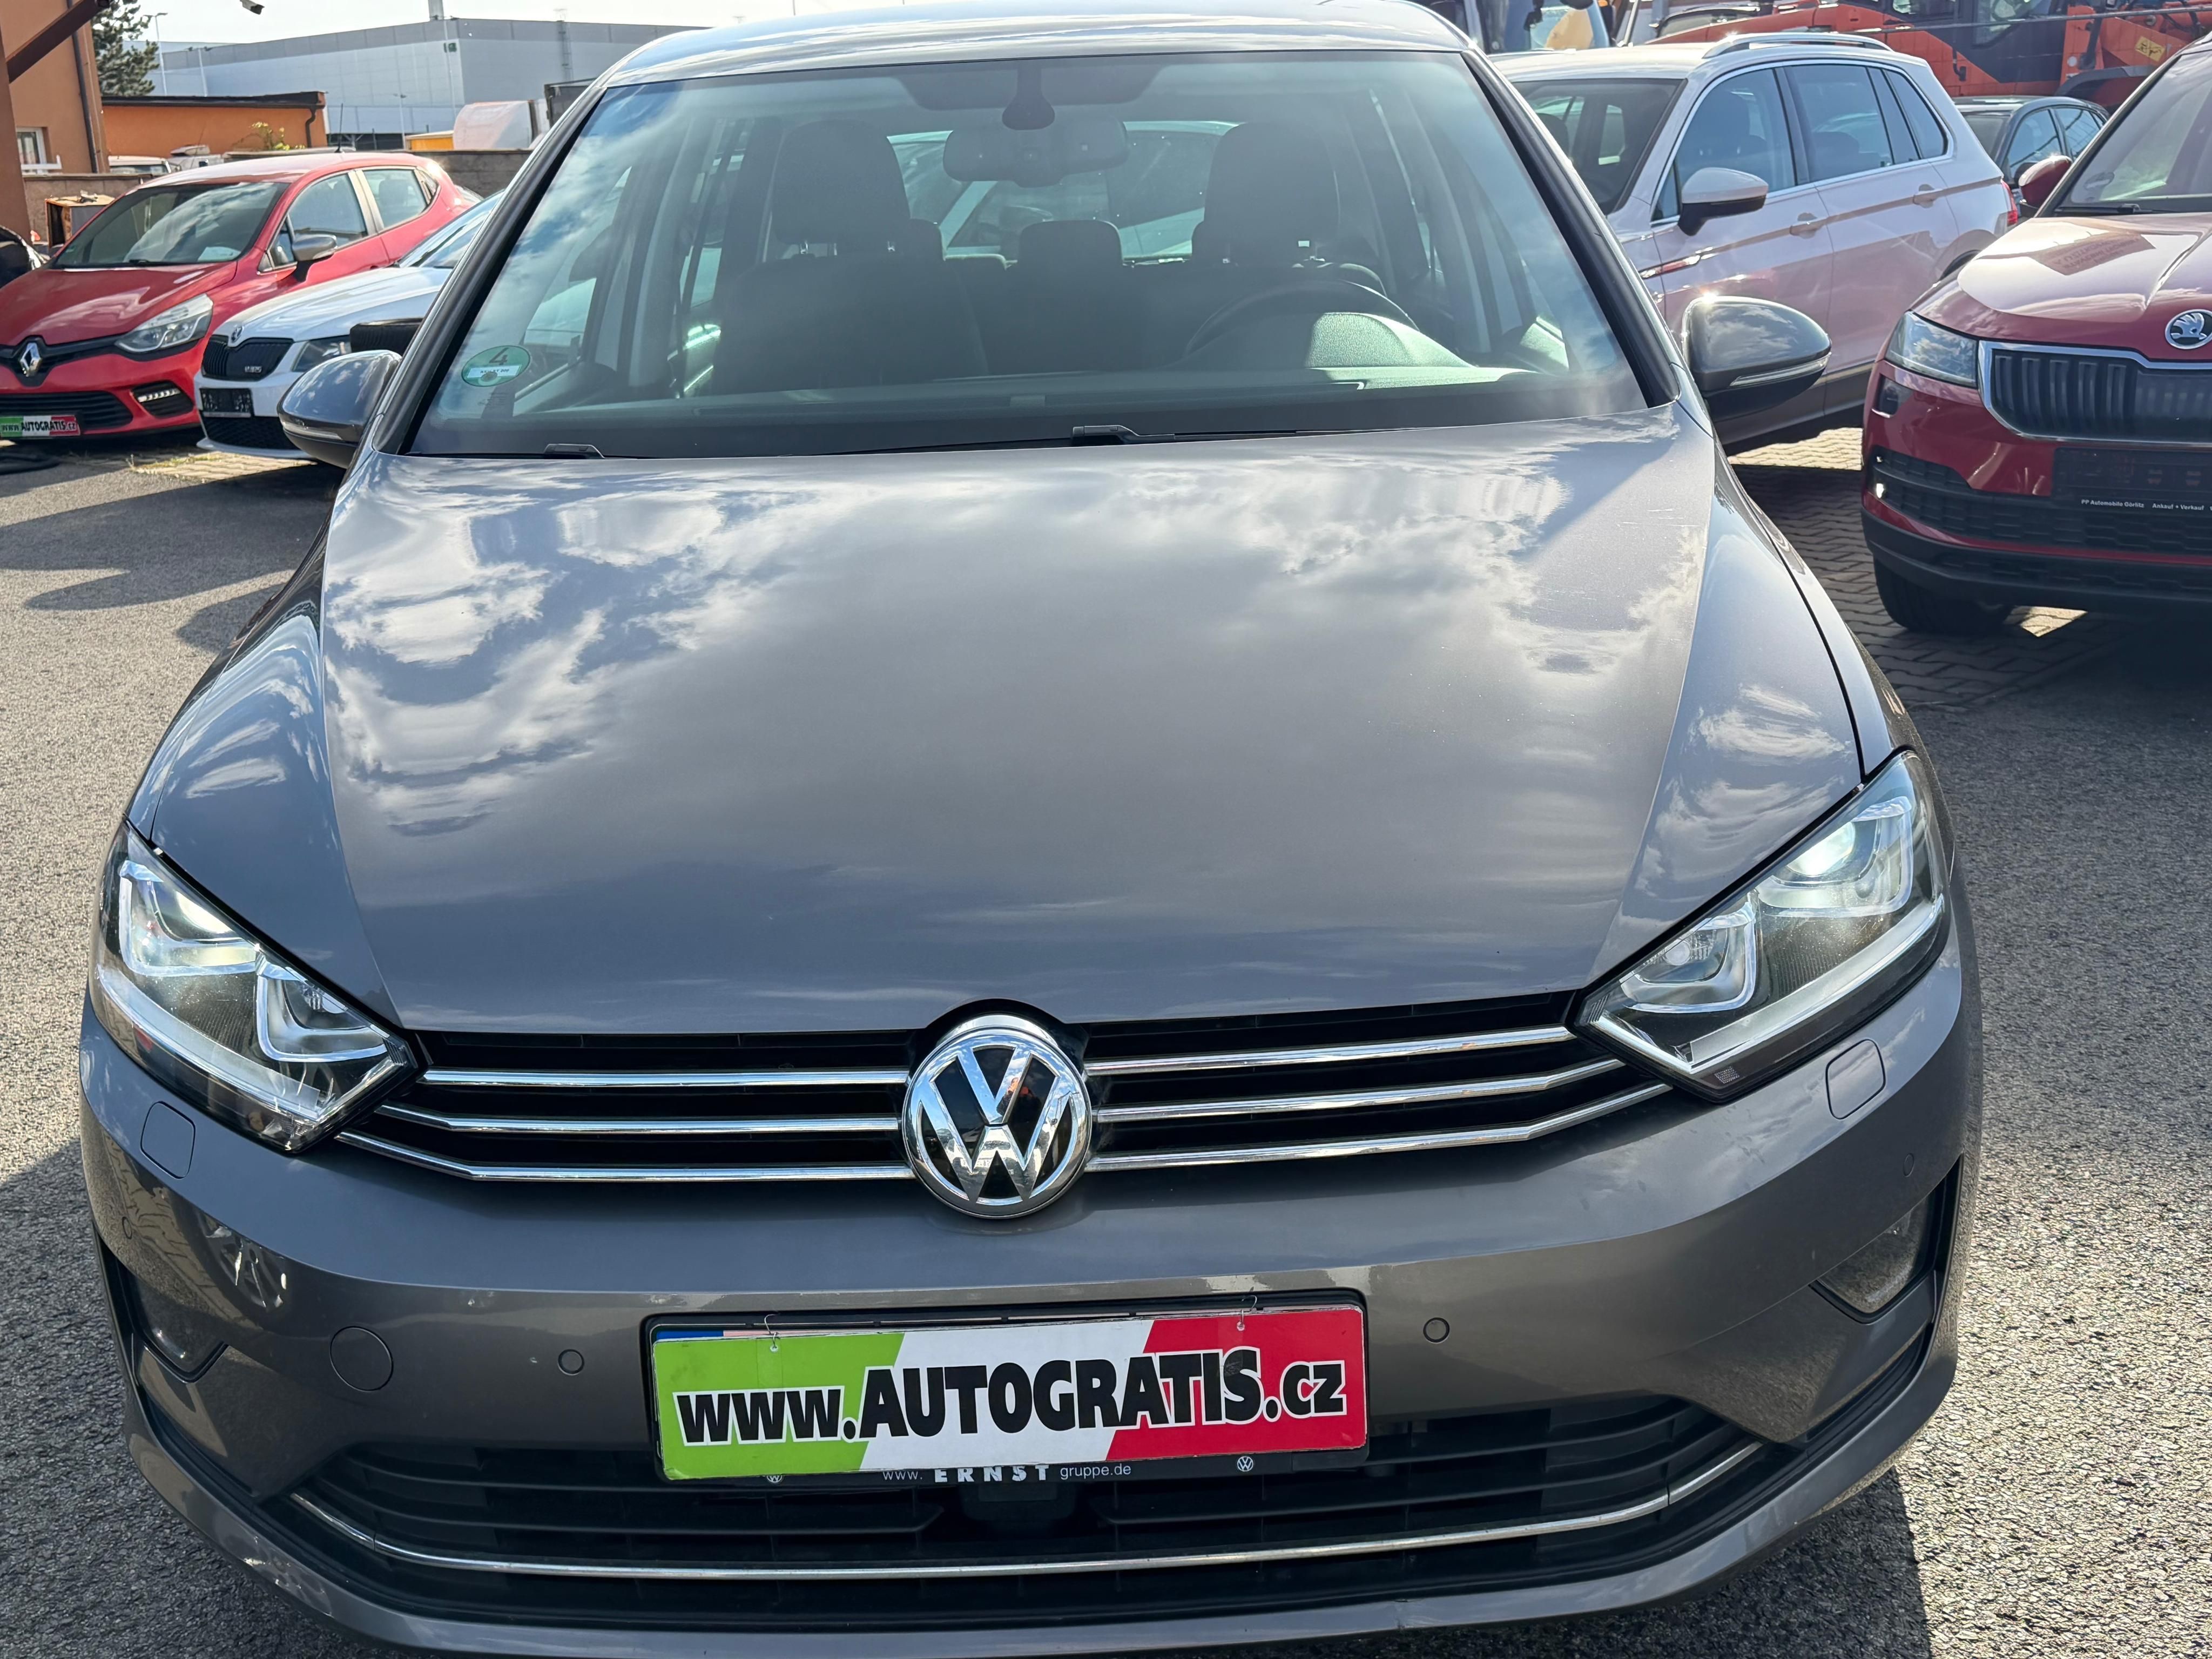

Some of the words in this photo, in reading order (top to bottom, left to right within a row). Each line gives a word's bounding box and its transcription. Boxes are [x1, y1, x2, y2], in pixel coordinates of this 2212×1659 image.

[489, 347, 509, 365] 4
[882, 1470, 922, 1480] www.
[935, 1465, 1049, 1482] ERNST
[1060, 1463, 1131, 1480] gruppe.de
